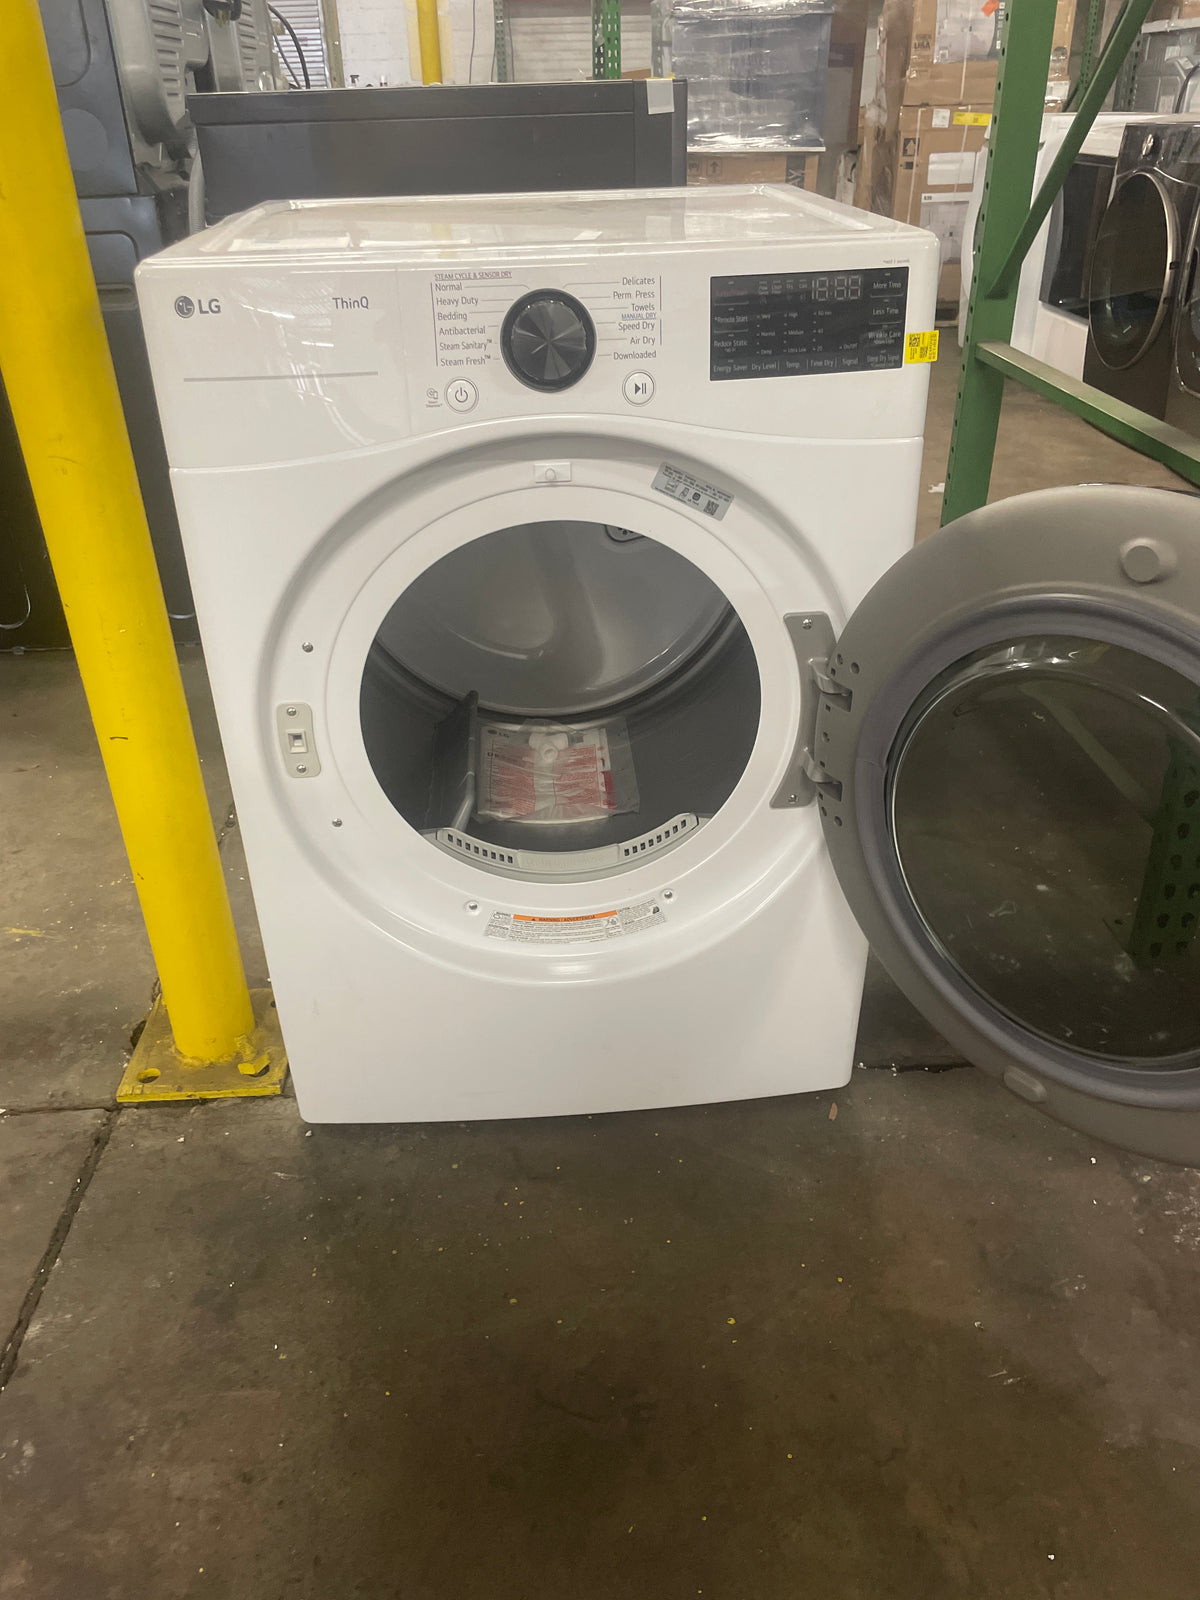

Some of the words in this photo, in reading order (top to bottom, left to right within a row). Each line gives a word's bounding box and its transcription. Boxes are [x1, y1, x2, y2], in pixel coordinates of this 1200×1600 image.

[434, 272, 454, 280] STEAM
[455, 272, 471, 280] CYCLE
[479, 271, 500, 279] SENSOR
[501, 270, 513, 278] DRY
[434, 281, 463, 291] Normal
[622, 276, 656, 286] Delicates
[613, 290, 632, 300] Perm
[635, 290, 655, 299] Press
[332, 295, 369, 310] ThinQ
[436, 297, 459, 307] Heavy
[461, 296, 479, 306] Duty
[198, 299, 221, 315] LG
[631, 302, 656, 312] Towels
[886, 307, 899, 315] Time
[437, 311, 468, 322] Bedding
[439, 325, 486, 336] Antibacterial
[618, 321, 640, 332] Speed
[642, 320, 656, 331] Dry
[888, 330, 902, 338] Care
[630, 336, 640, 345] Air
[642, 336, 656, 346] Dry
[713, 340, 732, 348] Reduce
[439, 342, 460, 351] Steam
[613, 350, 657, 360] Downloaded
[440, 357, 464, 367] Steam
[751, 363, 761, 371] Dry
[762, 361, 777, 370] Level
[810, 359, 823, 367] Time
[823, 359, 834, 368] Dry
[713, 364, 732, 373] Energy
